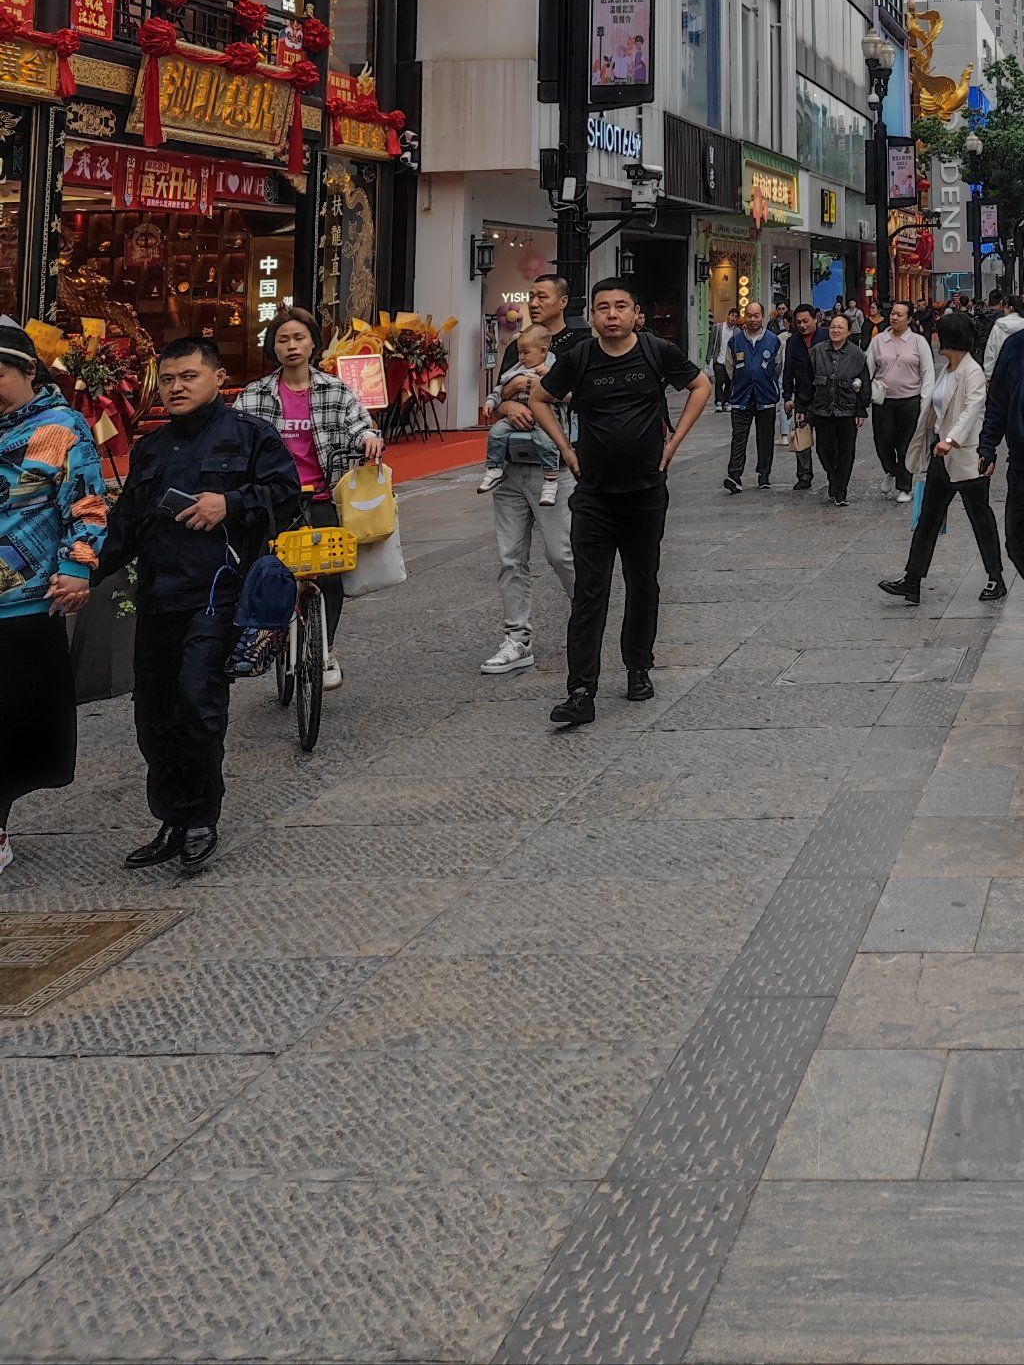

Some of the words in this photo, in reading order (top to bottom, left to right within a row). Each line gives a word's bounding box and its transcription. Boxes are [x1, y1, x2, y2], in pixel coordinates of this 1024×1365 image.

[76, 152, 113, 181] 武汉
[142, 167, 197, 201] 盛大开业
